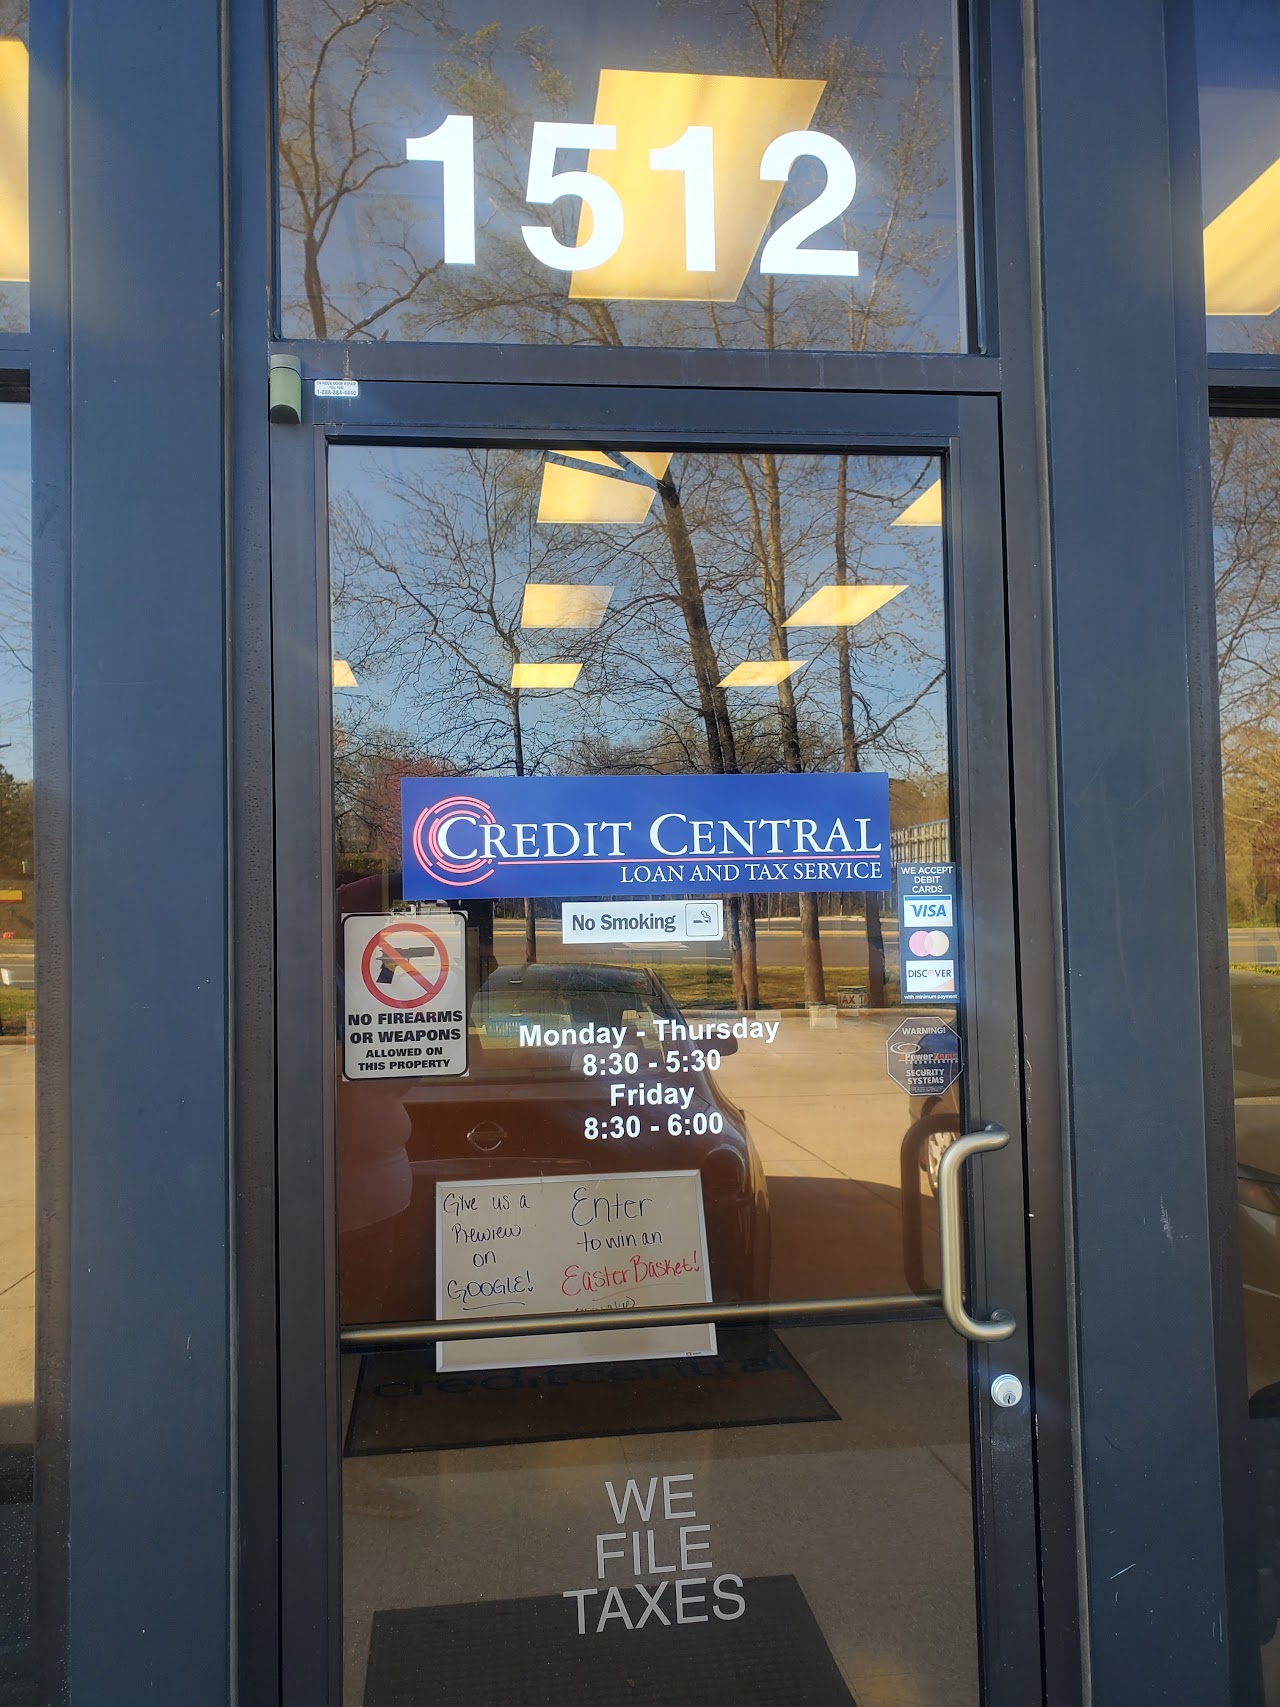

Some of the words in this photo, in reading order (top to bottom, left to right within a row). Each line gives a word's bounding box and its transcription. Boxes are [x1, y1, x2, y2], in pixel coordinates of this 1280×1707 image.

[406, 114, 859, 277] 1512
[437, 816, 632, 861] CREDIT
[649, 813, 882, 856] CENTRAL
[620, 865, 684, 883] LOAN
[689, 865, 740, 882] AND
[744, 864, 790, 881] TAX
[792, 862, 883, 881] SERVICE
[901, 867, 916, 875] WE
[918, 866, 953, 875] ACCEPT
[914, 876, 940, 884] DEBIT
[912, 885, 943, 893] CARDS
[910, 904, 947, 918] VISA
[572, 915, 596, 931] No
[600, 913, 677, 933] Smoking
[348, 1013, 372, 1026] NO
[378, 1010, 463, 1025] FIREARMS
[350, 1031, 374, 1044] OR
[378, 1028, 461, 1043] WEAPONS
[519, 1022, 627, 1049] Monday
[653, 1017, 780, 1043] Thursday
[902, 1026, 946, 1035] WARNING!
[365, 1047, 422, 1058] ALLOWED
[426, 1047, 443, 1056] ON
[583, 1052, 639, 1076] 8:30
[666, 1049, 721, 1073] 5:30
[358, 1061, 385, 1071] THIS
[389, 1059, 451, 1070] PROPERTY
[906, 1069, 945, 1077] SECURITY
[907, 1076, 945, 1085] SYSTEMS
[610, 1082, 695, 1110] Friday
[584, 1115, 641, 1140] 8:30
[667, 1112, 723, 1136] 6:00
[443, 1192, 478, 1216] Give
[492, 1194, 510, 1211] us
[519, 1194, 530, 1210] a
[571, 1187, 653, 1226] Enter
[576, 1232, 602, 1252] to
[608, 1230, 636, 1248] win
[642, 1230, 662, 1246] an
[472, 1250, 497, 1267] on
[561, 1264, 628, 1296] Easter
[630, 1250, 700, 1284] Basket!
[447, 1270, 534, 1303] GOOGLE!
[604, 1473, 697, 1524] WE
[596, 1524, 713, 1579] FILE
[562, 1573, 746, 1635] TAXES
